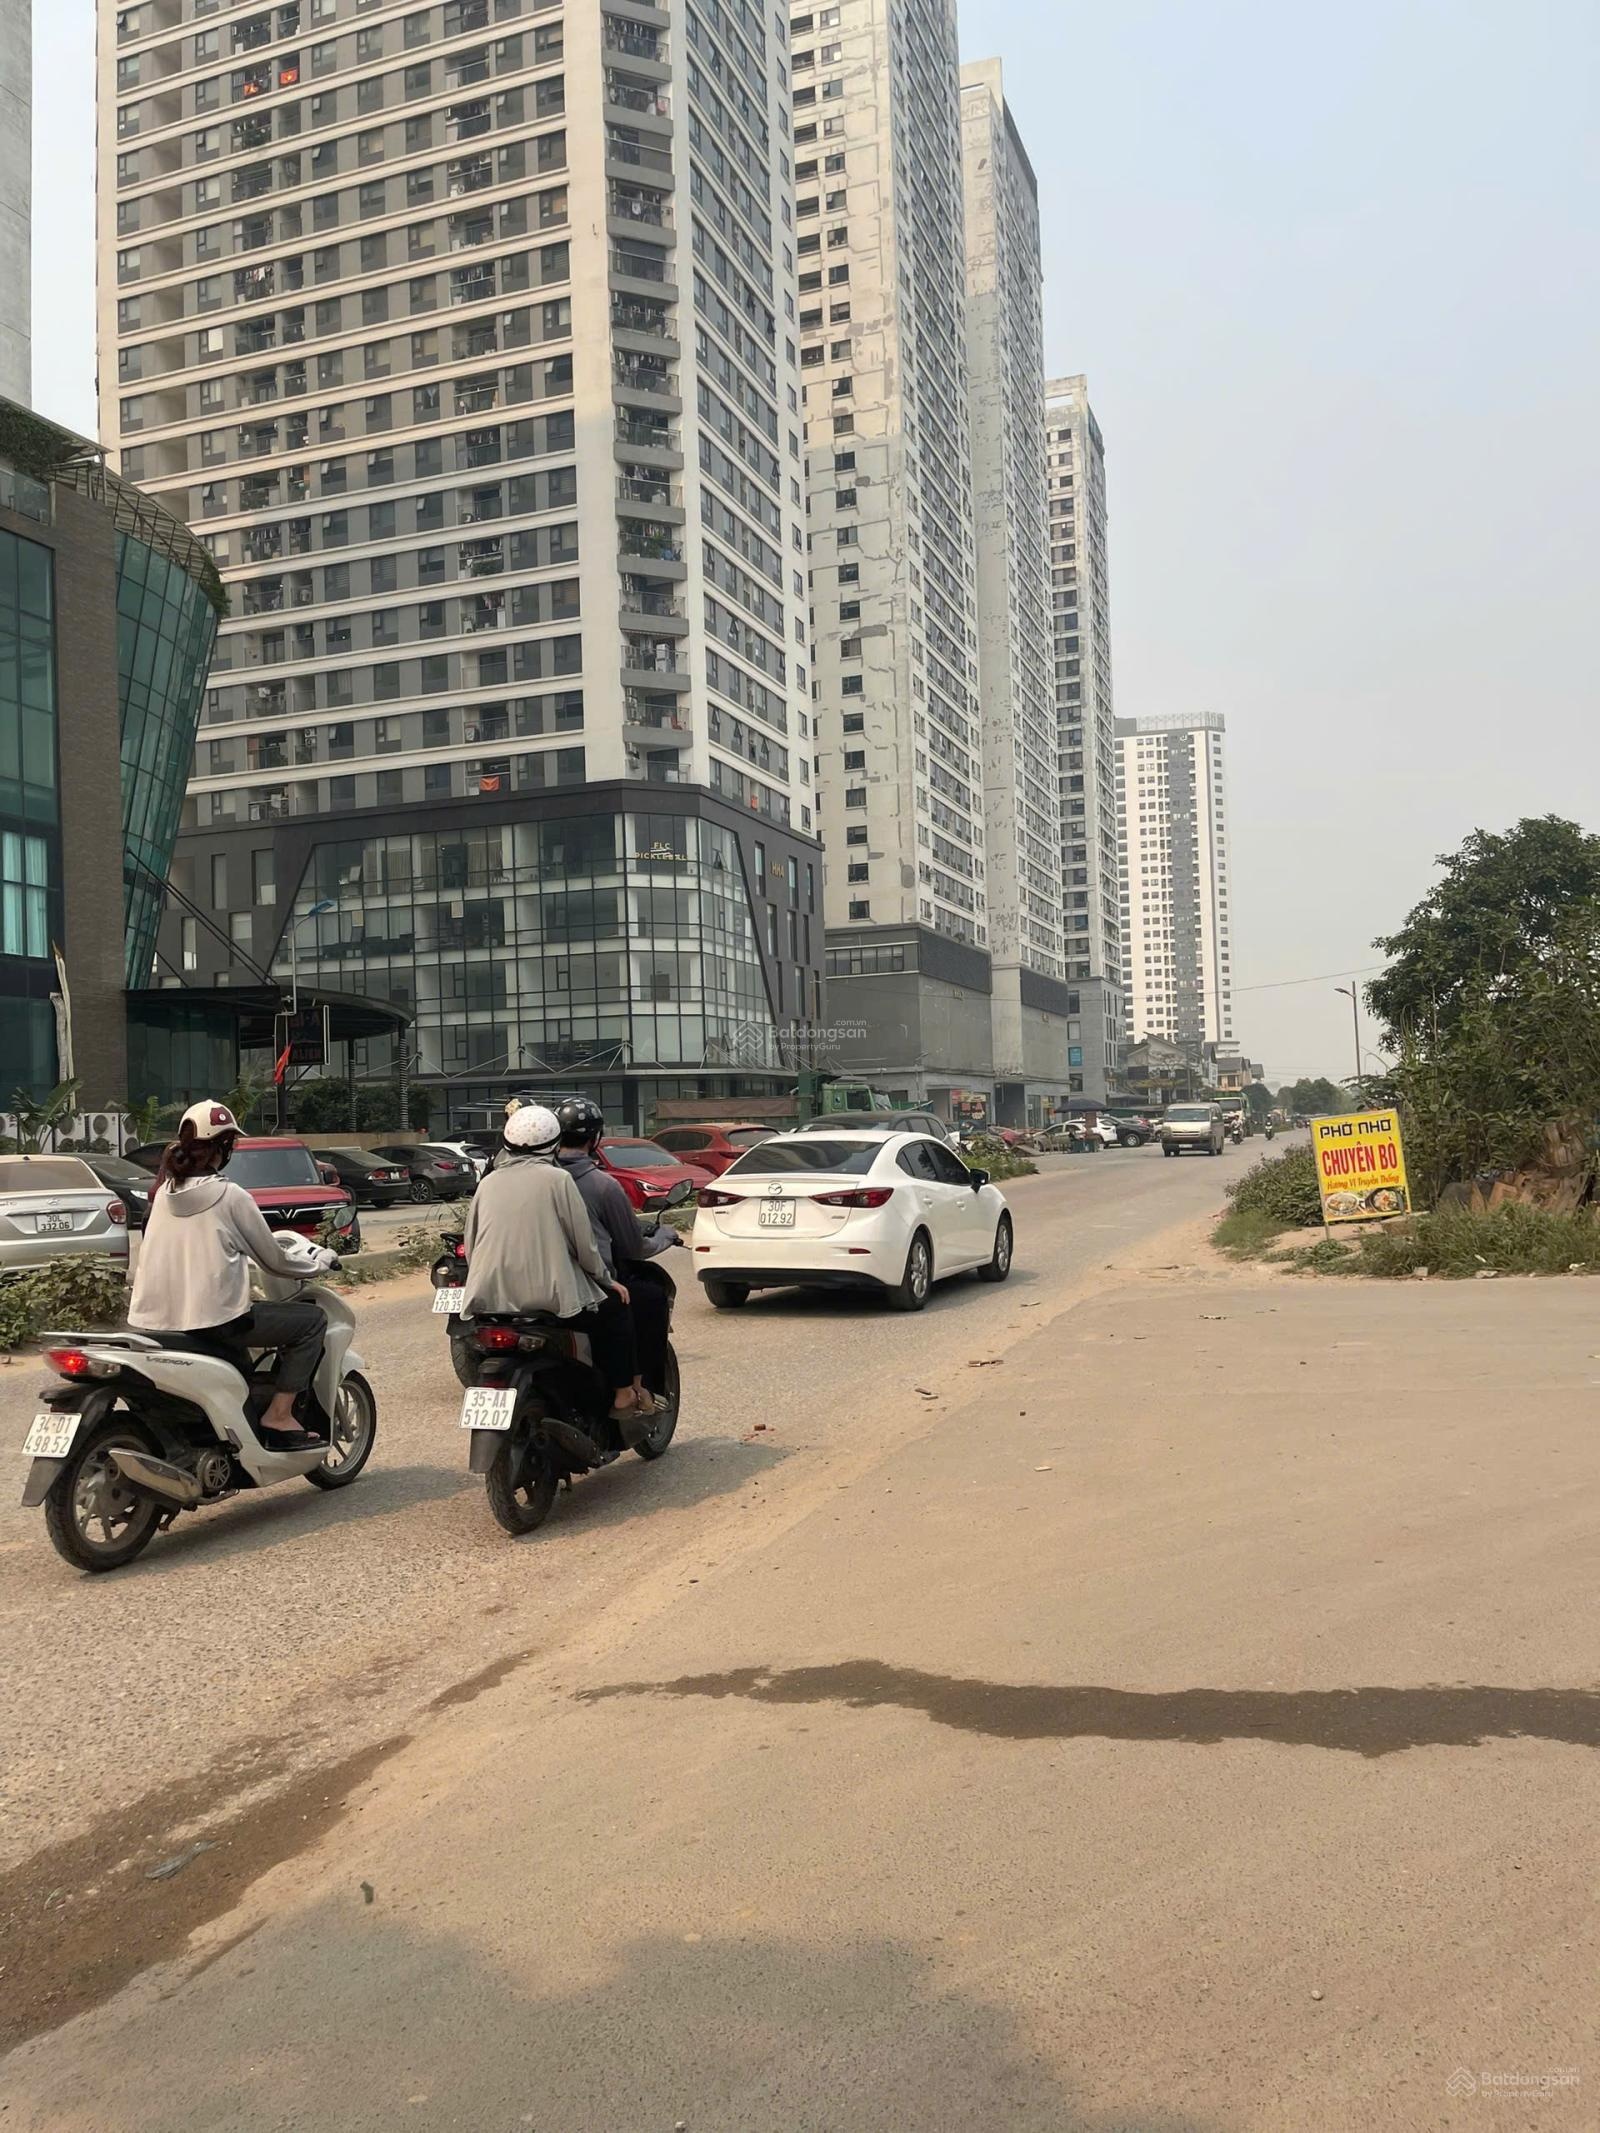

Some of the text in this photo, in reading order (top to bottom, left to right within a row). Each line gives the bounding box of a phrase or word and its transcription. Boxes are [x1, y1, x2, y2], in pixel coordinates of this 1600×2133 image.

[1321, 1137, 1398, 1177] CHUYÊN BÒ
[767, 1201, 787, 1212] 30F
[47, 1215, 62, 1223] 30L
[760, 1213, 793, 1224] 012.92
[41, 1222, 70, 1231] 332.06
[471, 1391, 507, 1408] 35-AA
[464, 1408, 509, 1426] 512.07
[25, 1435, 70, 1454] 498.52
